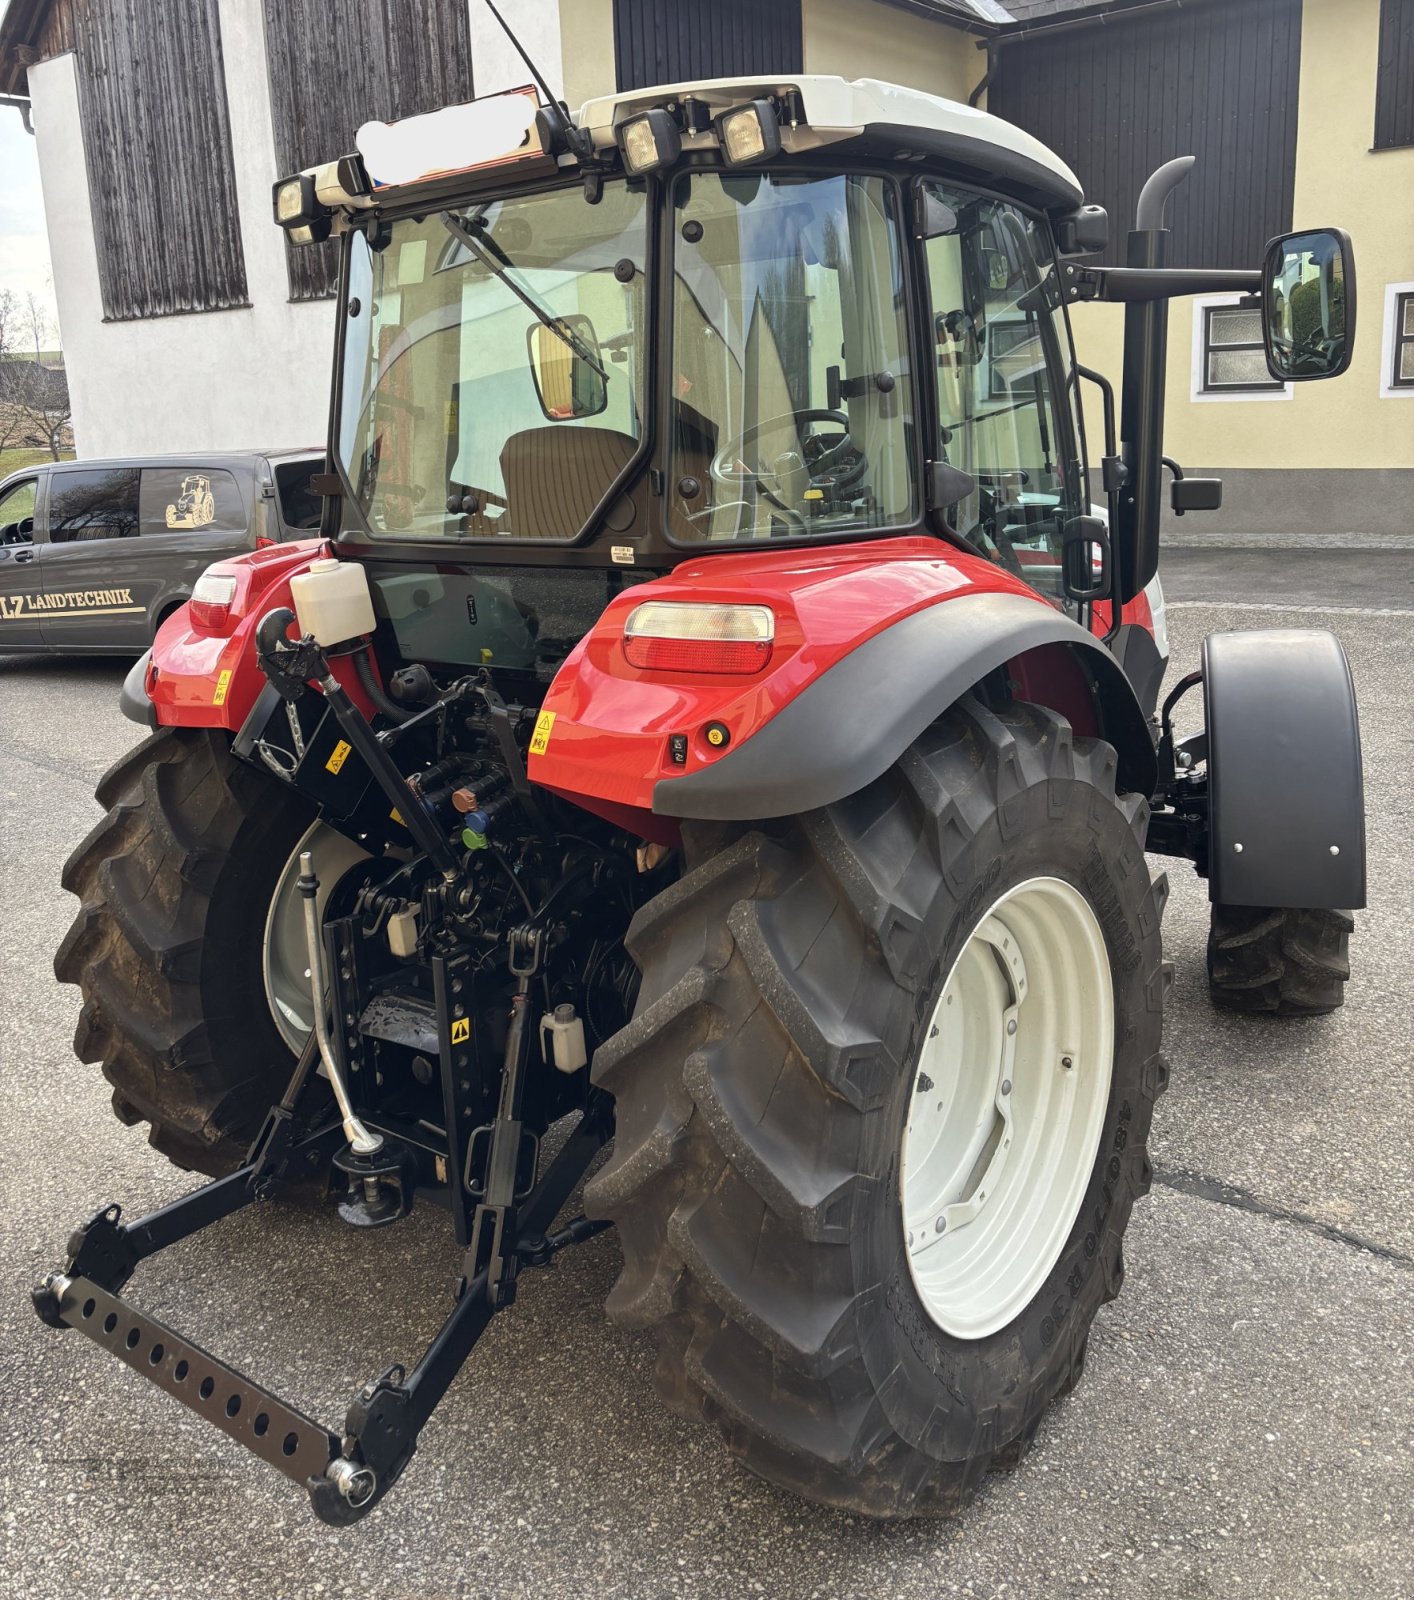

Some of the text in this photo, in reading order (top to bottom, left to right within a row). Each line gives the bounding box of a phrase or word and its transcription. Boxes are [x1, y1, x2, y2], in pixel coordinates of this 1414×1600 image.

[0, 588, 134, 618] LZ LANDTECHNIK
[1065, 1262, 1082, 1298] R
[1039, 1294, 1070, 1346] 30
